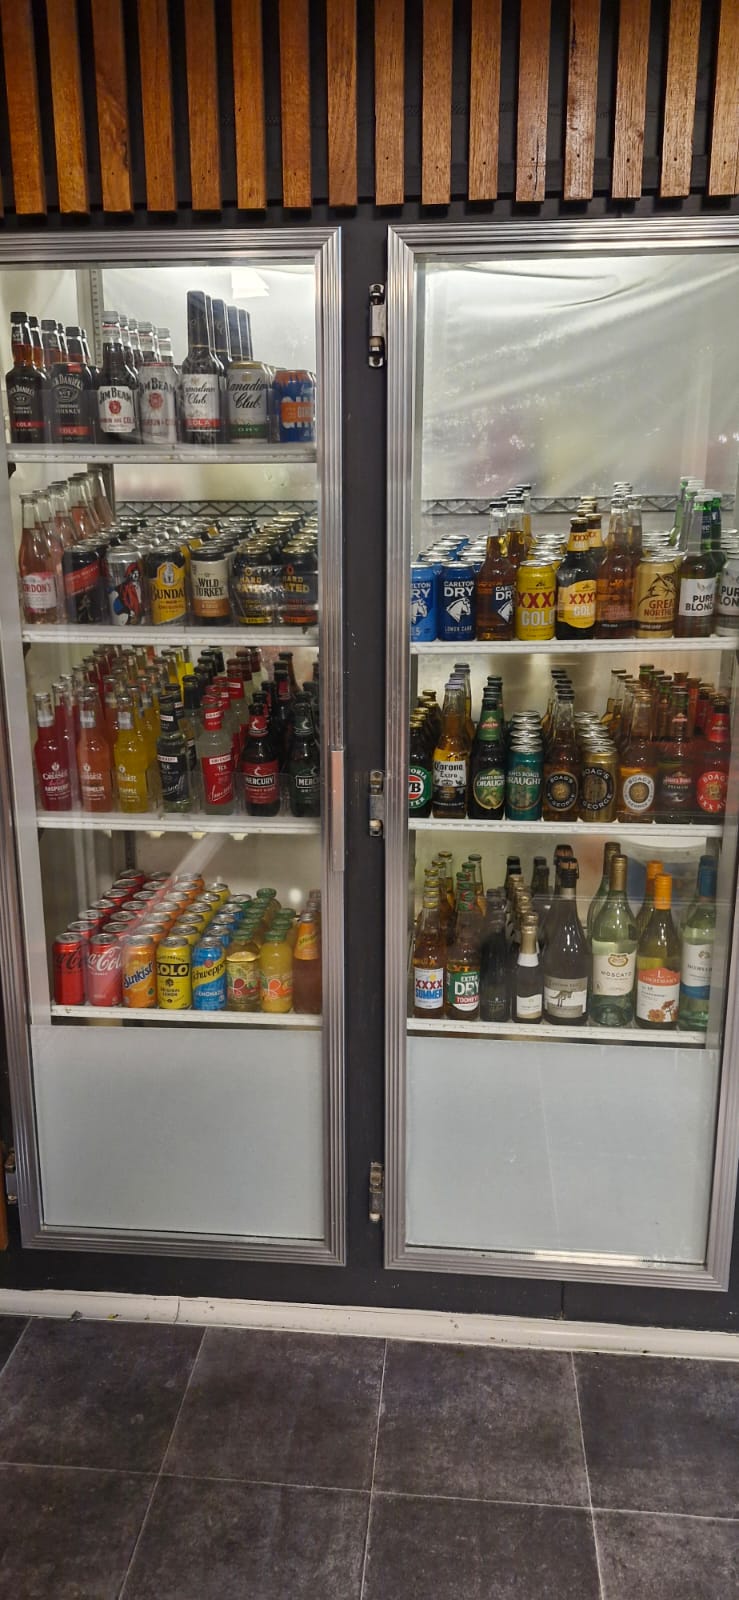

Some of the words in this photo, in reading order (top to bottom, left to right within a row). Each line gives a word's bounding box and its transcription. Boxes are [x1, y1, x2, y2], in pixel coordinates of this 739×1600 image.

[186, 383, 216, 392] anadian
[100, 390, 110, 404] JIM
[111, 387, 132, 403] BEAM
[186, 393, 206, 404] Club
[233, 392, 262, 408] Club
[198, 578, 219, 587] WILD
[23, 583, 51, 593] ORDON'S
[194, 586, 224, 597] TURKEY
[411, 588, 431, 598] RY
[444, 587, 474, 597] DRY
[496, 592, 514, 600] DR
[435, 762, 463, 771] Corona
[584, 768, 610, 780] OAG'S
[507, 777, 541, 785] RAUGHT
[703, 775, 728, 784] BOAG
[583, 794, 612, 810] GEORGE
[124, 961, 153, 988] Sunkist
[416, 979, 442, 989] XXXX
[416, 989, 442, 999] SUMMER
